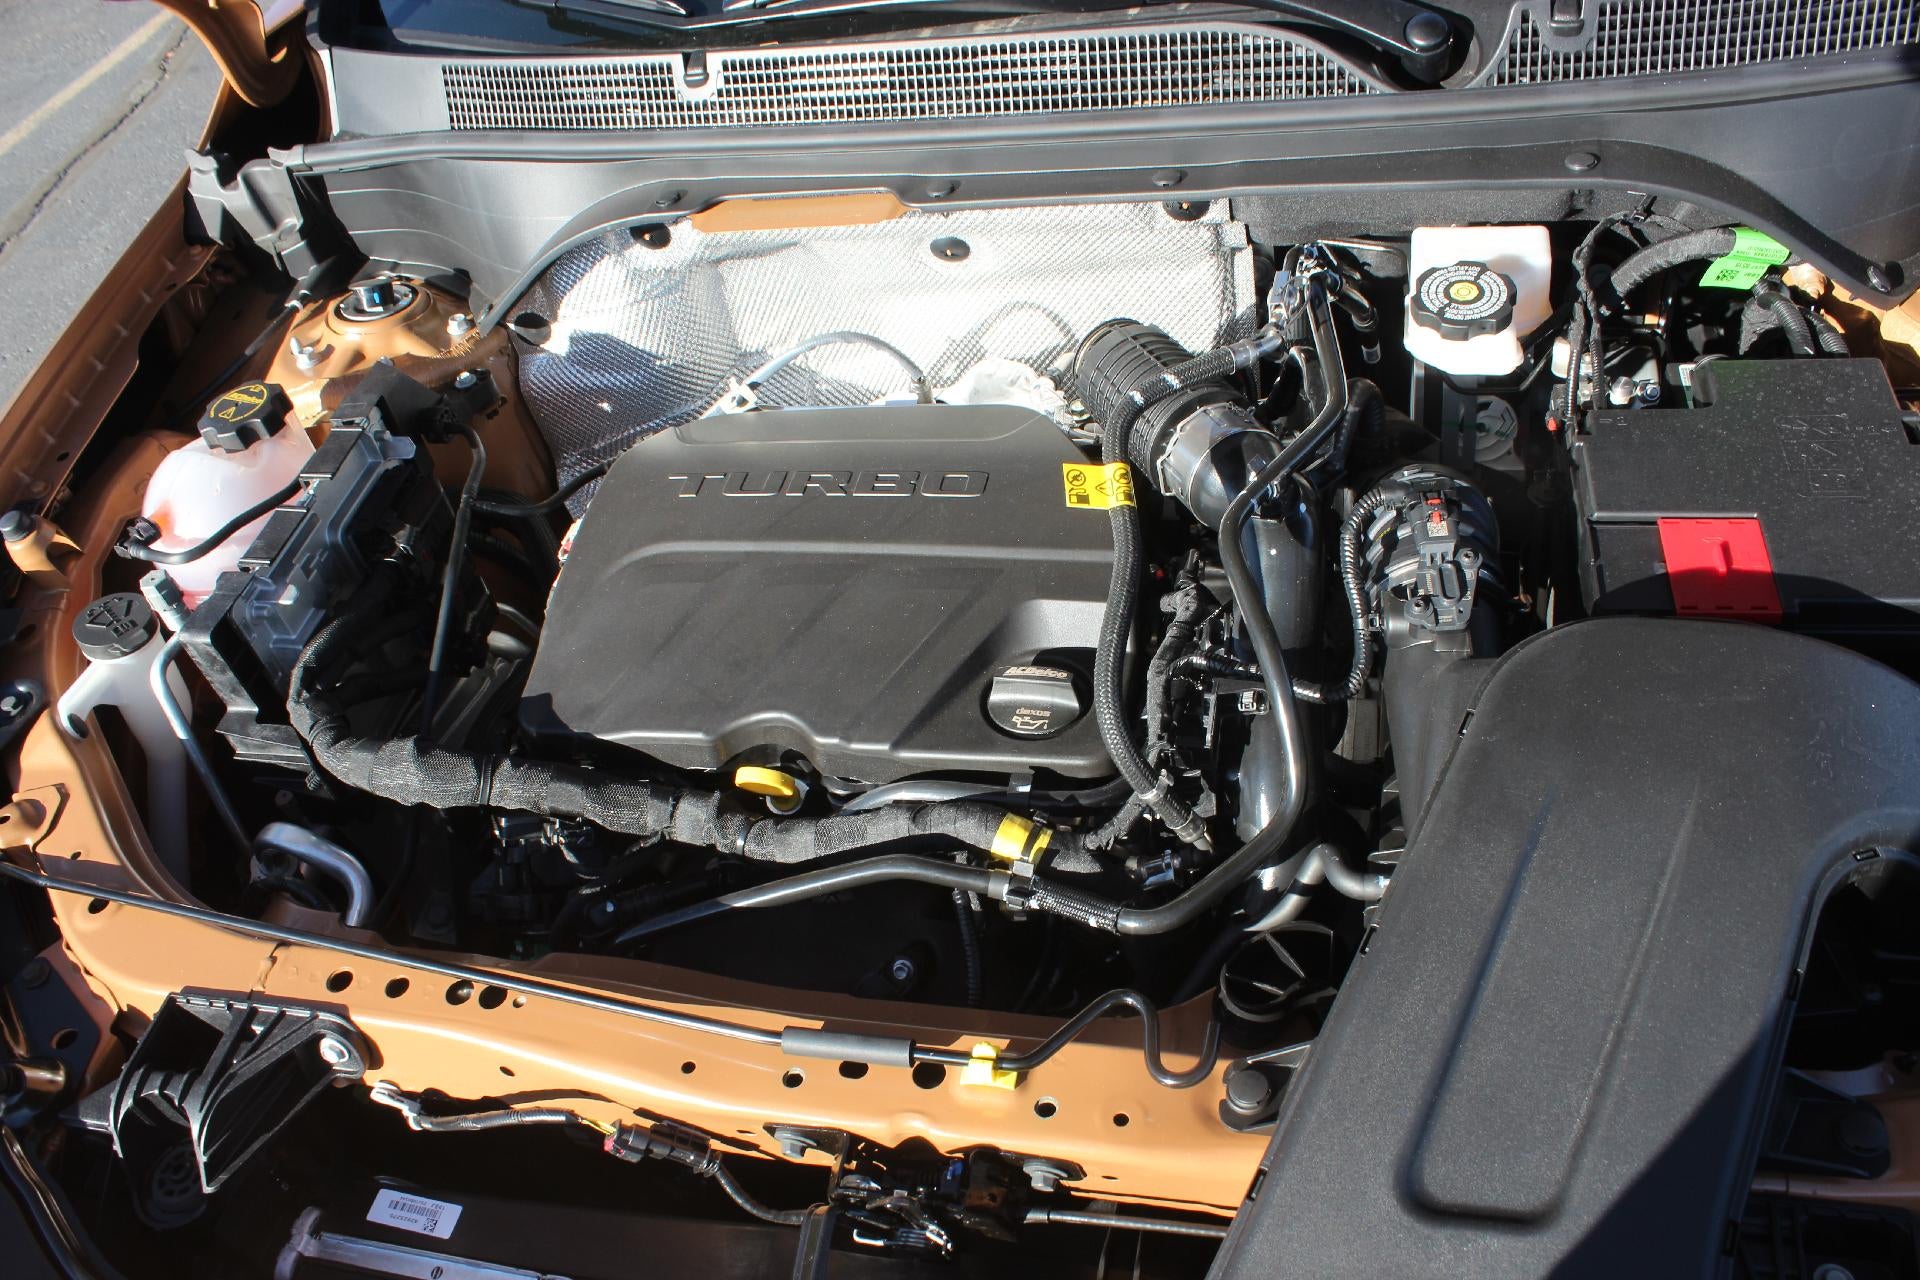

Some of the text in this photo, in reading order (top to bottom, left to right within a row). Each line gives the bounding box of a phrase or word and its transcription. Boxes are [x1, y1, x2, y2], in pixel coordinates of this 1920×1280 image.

[668, 470, 990, 498] TURBO
[1003, 666, 1068, 679] ACDelco
[1016, 707, 1051, 717] dexos
